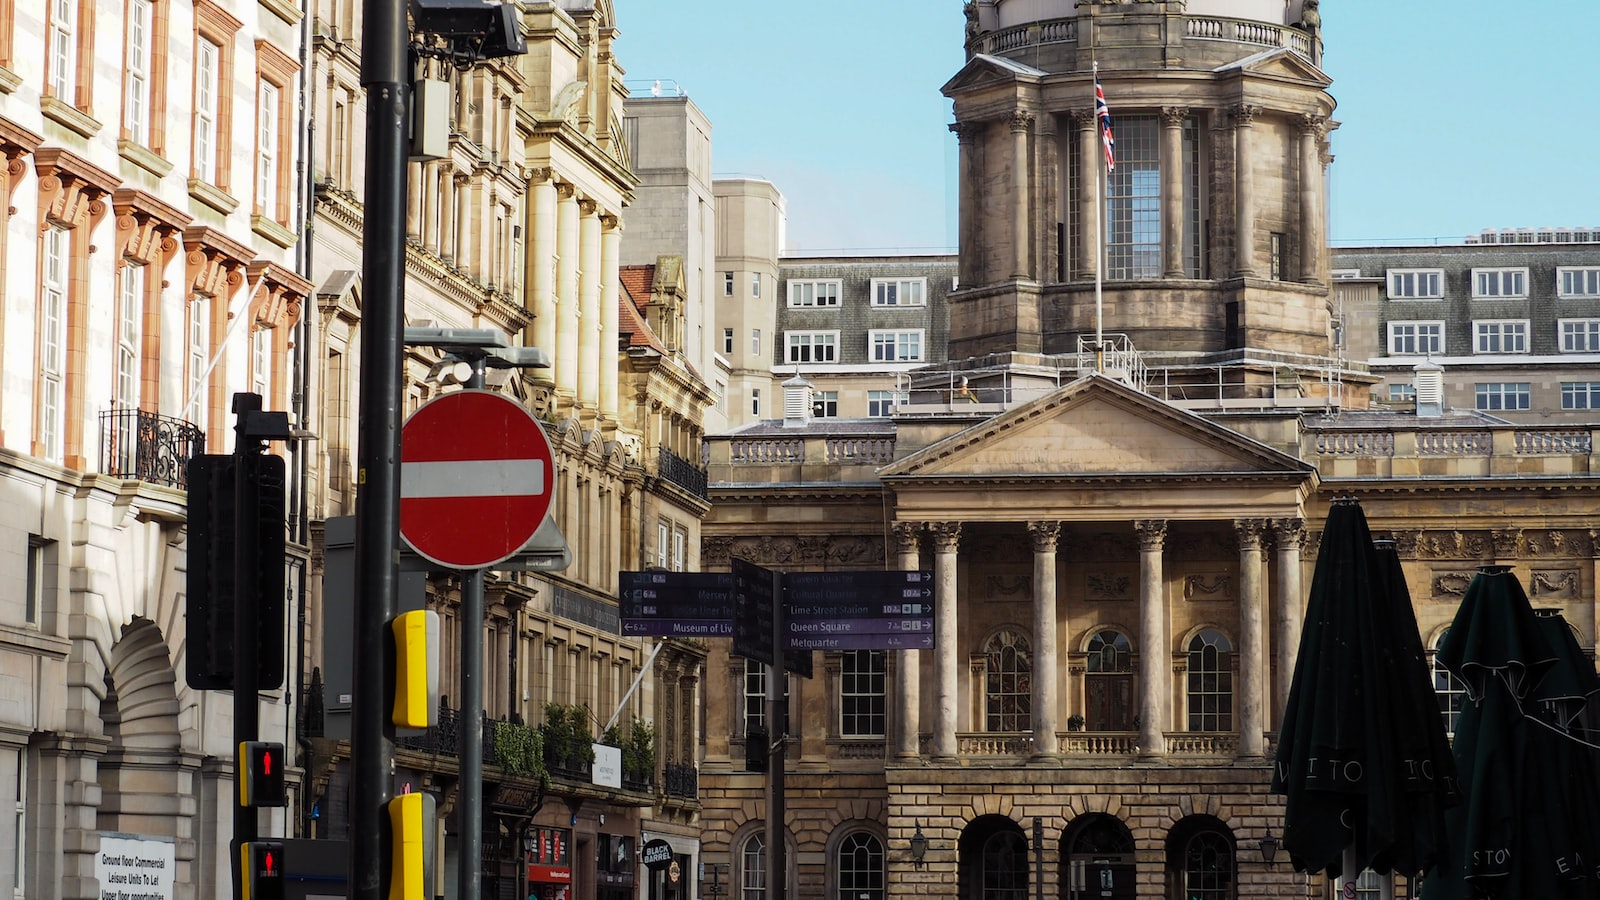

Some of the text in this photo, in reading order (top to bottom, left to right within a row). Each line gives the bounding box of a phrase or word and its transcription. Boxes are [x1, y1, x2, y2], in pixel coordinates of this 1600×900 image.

[643, 590, 648, 598] 6
[903, 589, 912, 598] 10
[790, 605, 813, 615] Lime
[813, 605, 839, 615] Street
[839, 605, 869, 615] Station
[883, 605, 892, 614] 10
[673, 623, 708, 633] Museum
[709, 623, 718, 633] of
[790, 622, 818, 633] Queen
[820, 621, 851, 633] Square
[790, 638, 839, 649] Metquarter
[646, 844, 669, 856] BLACK
[102, 853, 166, 869] Ground floor Commercial
[644, 852, 671, 864] BARREL
[108, 872, 159, 886] Leisure Units To Let
[101, 889, 165, 900] Upper floor opportunities
